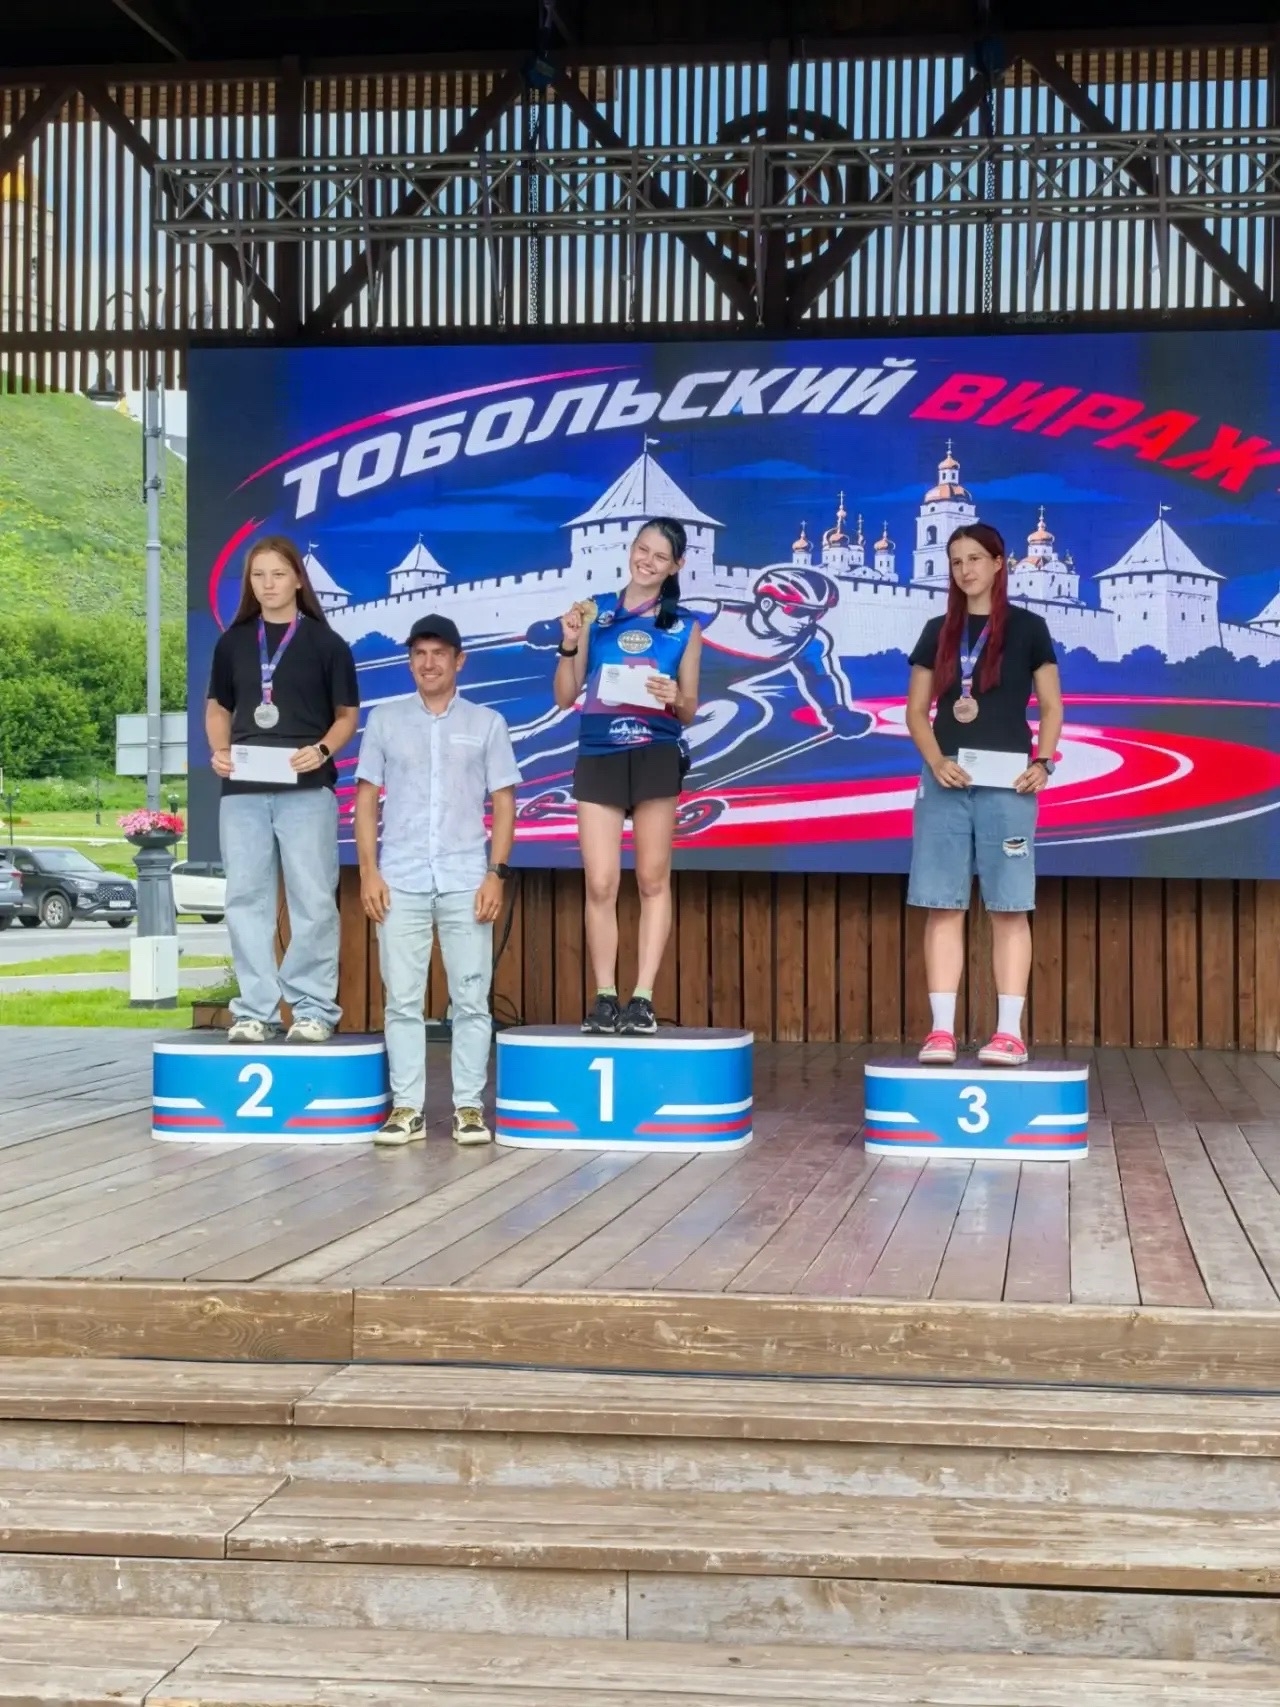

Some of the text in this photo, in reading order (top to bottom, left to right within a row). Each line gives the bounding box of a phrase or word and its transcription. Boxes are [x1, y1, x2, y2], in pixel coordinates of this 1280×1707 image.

[283, 358, 1280, 519] ТОБОЛЬСКИЙ ВИРАЖ
[236, 1062, 274, 1118] 2
[588, 1057, 615, 1123] 1
[957, 1085, 990, 1134] 3
